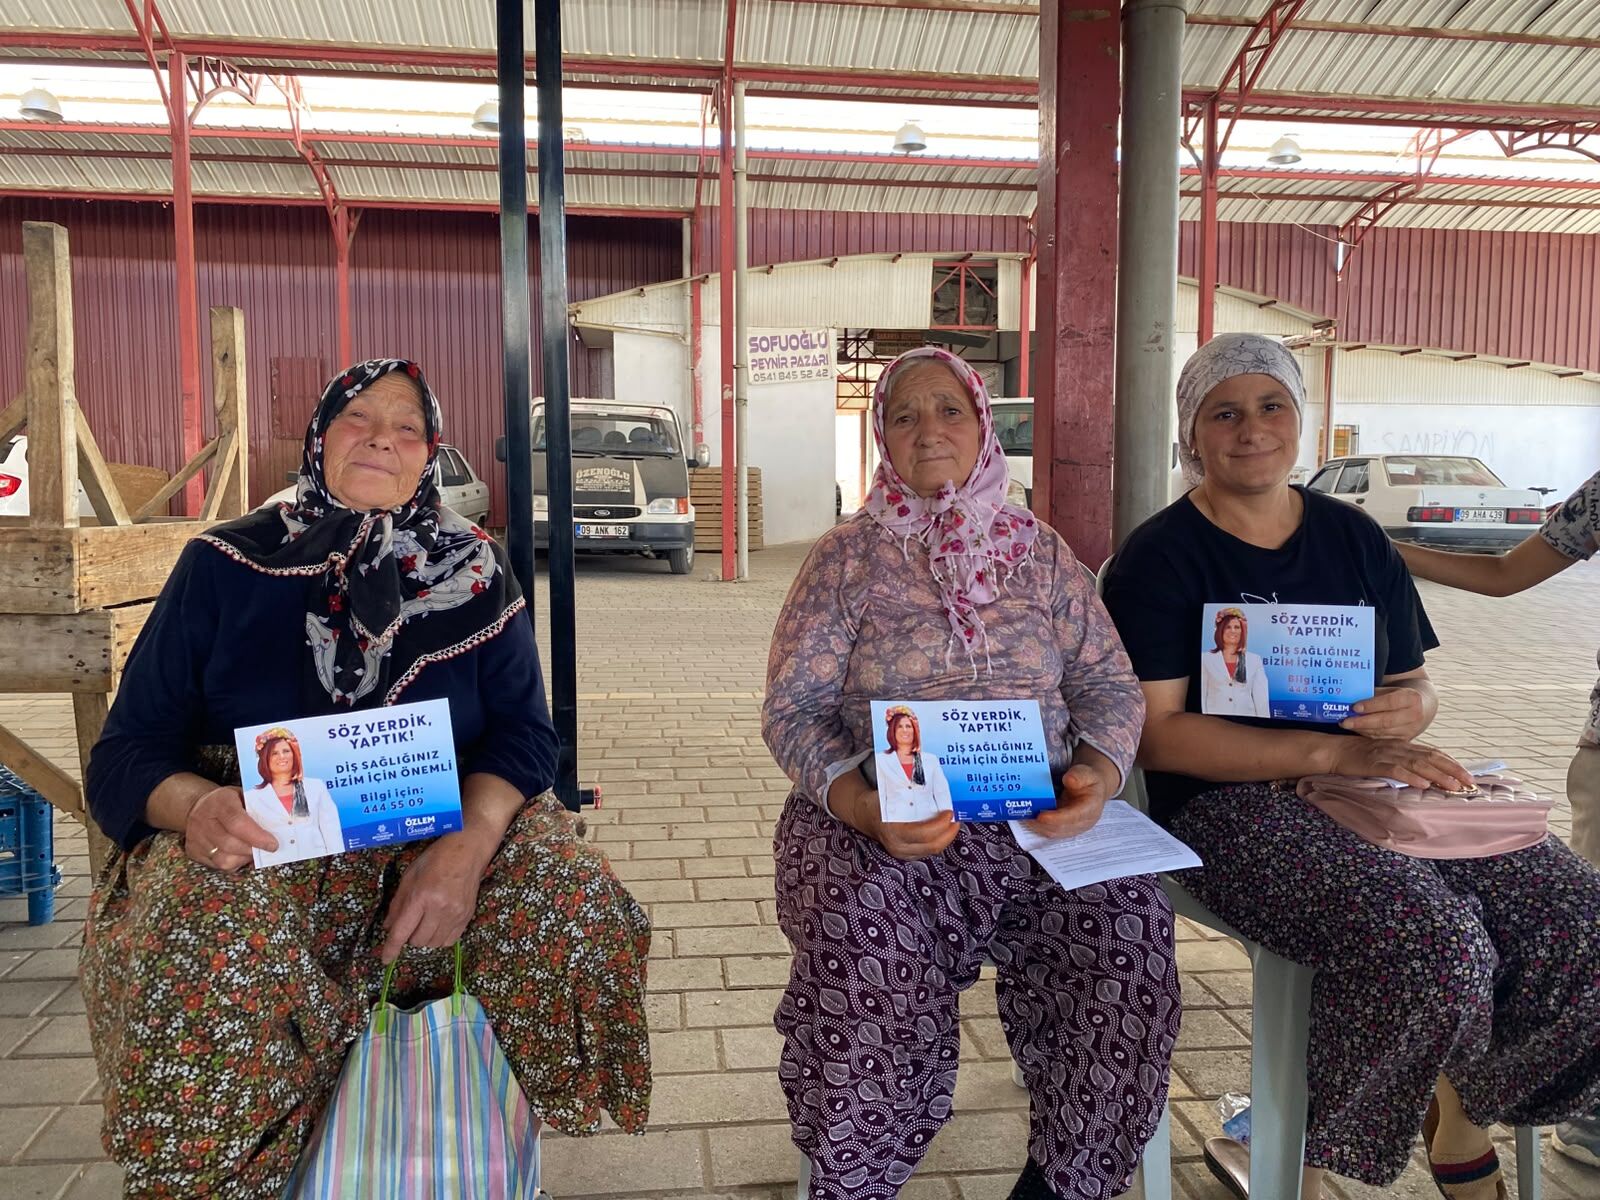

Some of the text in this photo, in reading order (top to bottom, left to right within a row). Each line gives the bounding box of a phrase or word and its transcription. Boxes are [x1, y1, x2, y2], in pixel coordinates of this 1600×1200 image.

[749, 330, 828, 353] SOFUOĞLU
[751, 354, 828, 370] PEYNİR PAZARI
[754, 369, 828, 382] 0541 845 52 42
[1460, 510, 1503, 519] 09 AHA 439
[582, 526, 627, 534] 09 ANK 162
[1271, 612, 1358, 628] SÖZ VERDİK,
[1288, 626, 1342, 637] YAPTIK!
[1272, 644, 1360, 657] DİŞ SAĞLIĞINIZ
[1262, 656, 1370, 670] BİZİM İÇİN ÖNEMLİ
[1288, 674, 1343, 686] Bilgi için:
[1289, 686, 1310, 695] 444
[1328, 687, 1342, 695] 09
[1322, 702, 1350, 711] ÖZLEM
[942, 708, 1026, 721] SÖZ VERDİK,
[328, 714, 432, 739] SÖZ VERDİK,
[959, 722, 1012, 732] YAPTIK!
[349, 730, 414, 749] YAPTIK!
[947, 741, 1033, 754] DİŞ SAĞLIĞINIZ
[336, 750, 439, 774] DİŞ SAĞLIĞINIZ
[939, 752, 1045, 766] BİZİM İÇİN ÖNEMLİ
[326, 759, 452, 789] BİZİM İÇİN ÖNEMLİ
[967, 773, 1021, 783] Bilgi için:
[360, 786, 424, 803] Bilgi için:
[970, 784, 1021, 792] 444 55 09
[363, 798, 424, 814] 444 55 09
[1005, 800, 1032, 808] ÖZLEM
[405, 816, 436, 827] ÖZLEM
